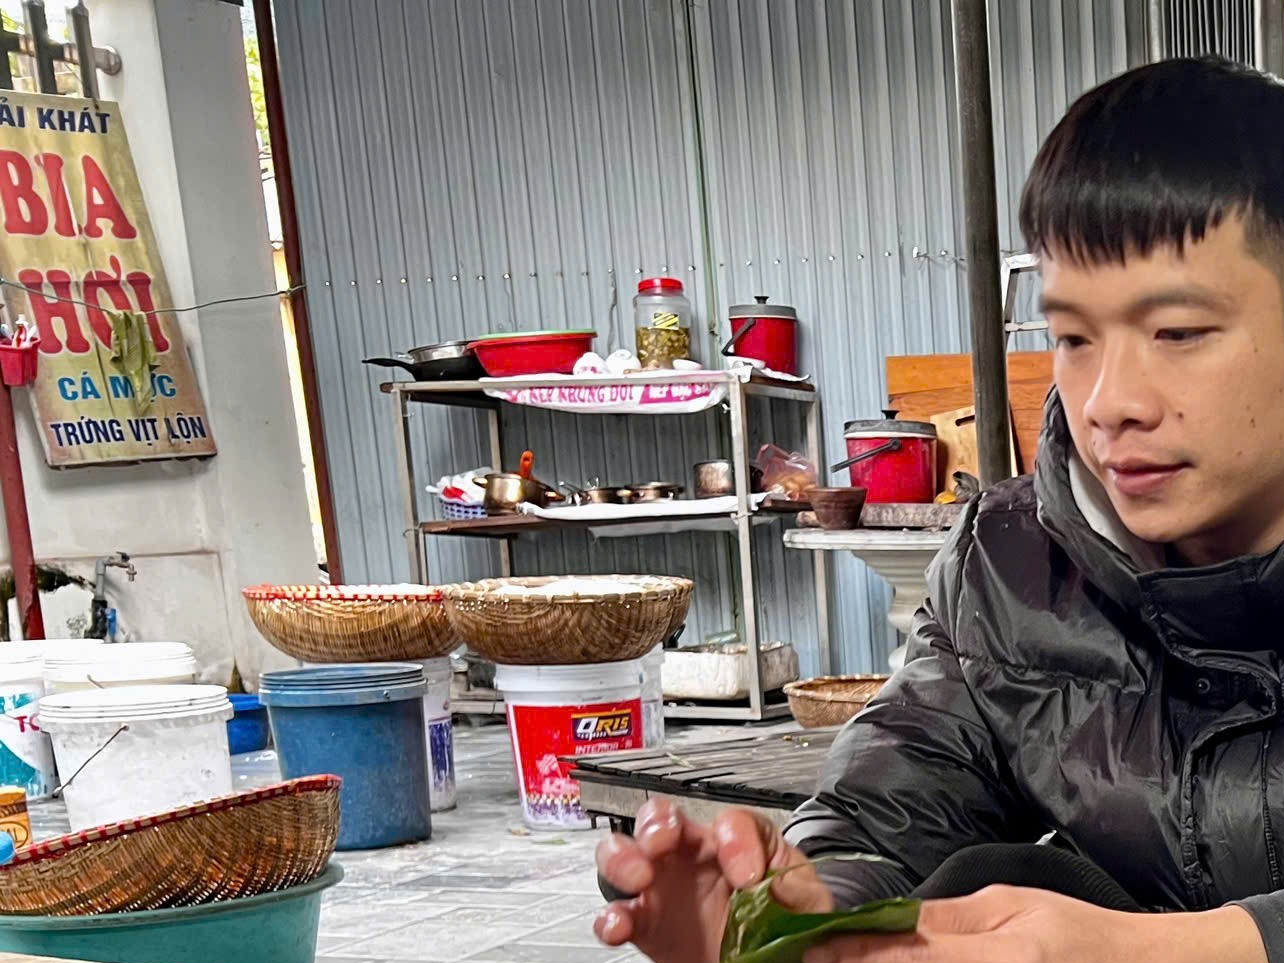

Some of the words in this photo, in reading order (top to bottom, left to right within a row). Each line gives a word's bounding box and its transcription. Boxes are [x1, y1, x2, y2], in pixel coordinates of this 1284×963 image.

[37, 106, 110, 134] KHÁT
[0, 150, 137, 239] BIA
[18, 255, 170, 353] HƠI
[57, 371, 100, 401] CÁ
[50, 416, 125, 447] TRỨNG
[128, 417, 159, 446] VỊT
[164, 412, 207, 444] LỘN
